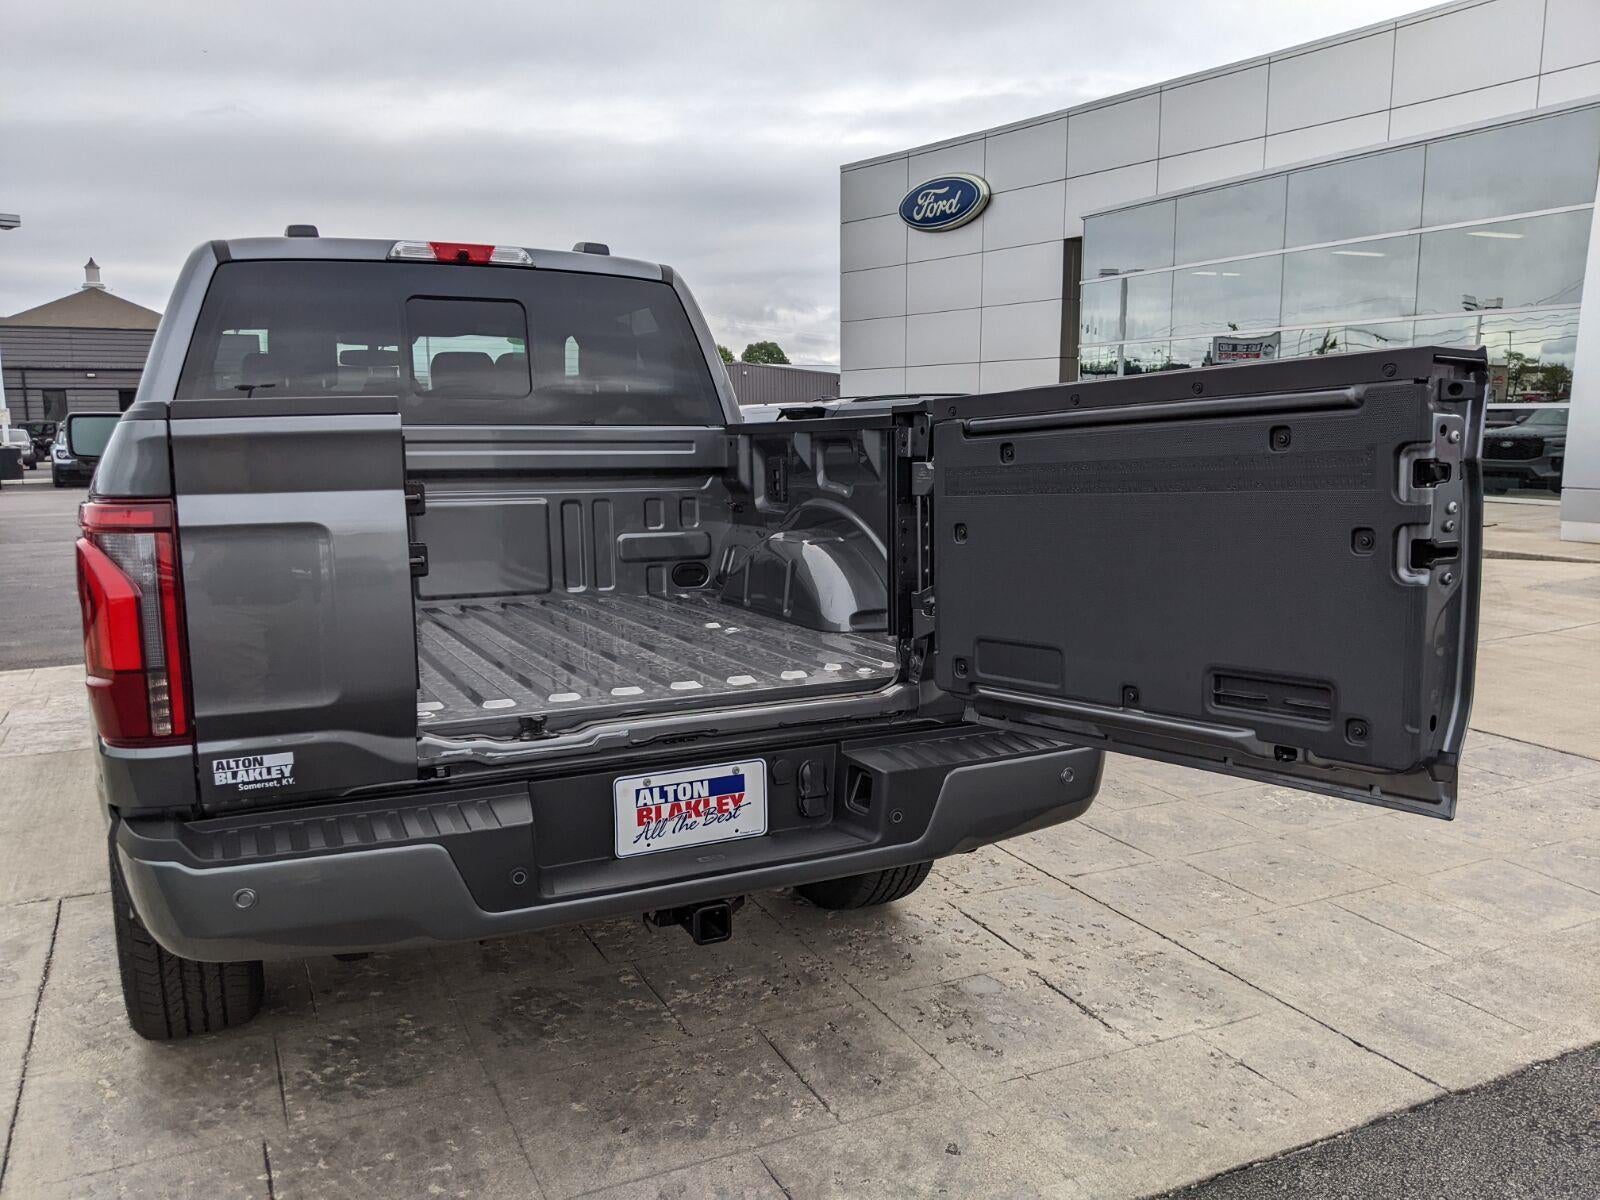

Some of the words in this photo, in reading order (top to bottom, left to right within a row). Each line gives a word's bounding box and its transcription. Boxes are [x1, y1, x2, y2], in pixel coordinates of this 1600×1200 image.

[913, 186, 962, 221] Ford
[214, 764, 293, 785] BLAKLEY
[215, 756, 264, 772] ALTON
[238, 780, 280, 791] Somerset,
[282, 777, 296, 786] KY.
[636, 780, 710, 807] ALTON
[633, 818, 667, 844] All
[671, 810, 700, 834] The
[702, 801, 751, 826] Best
[636, 793, 745, 826] BLAKLEY
